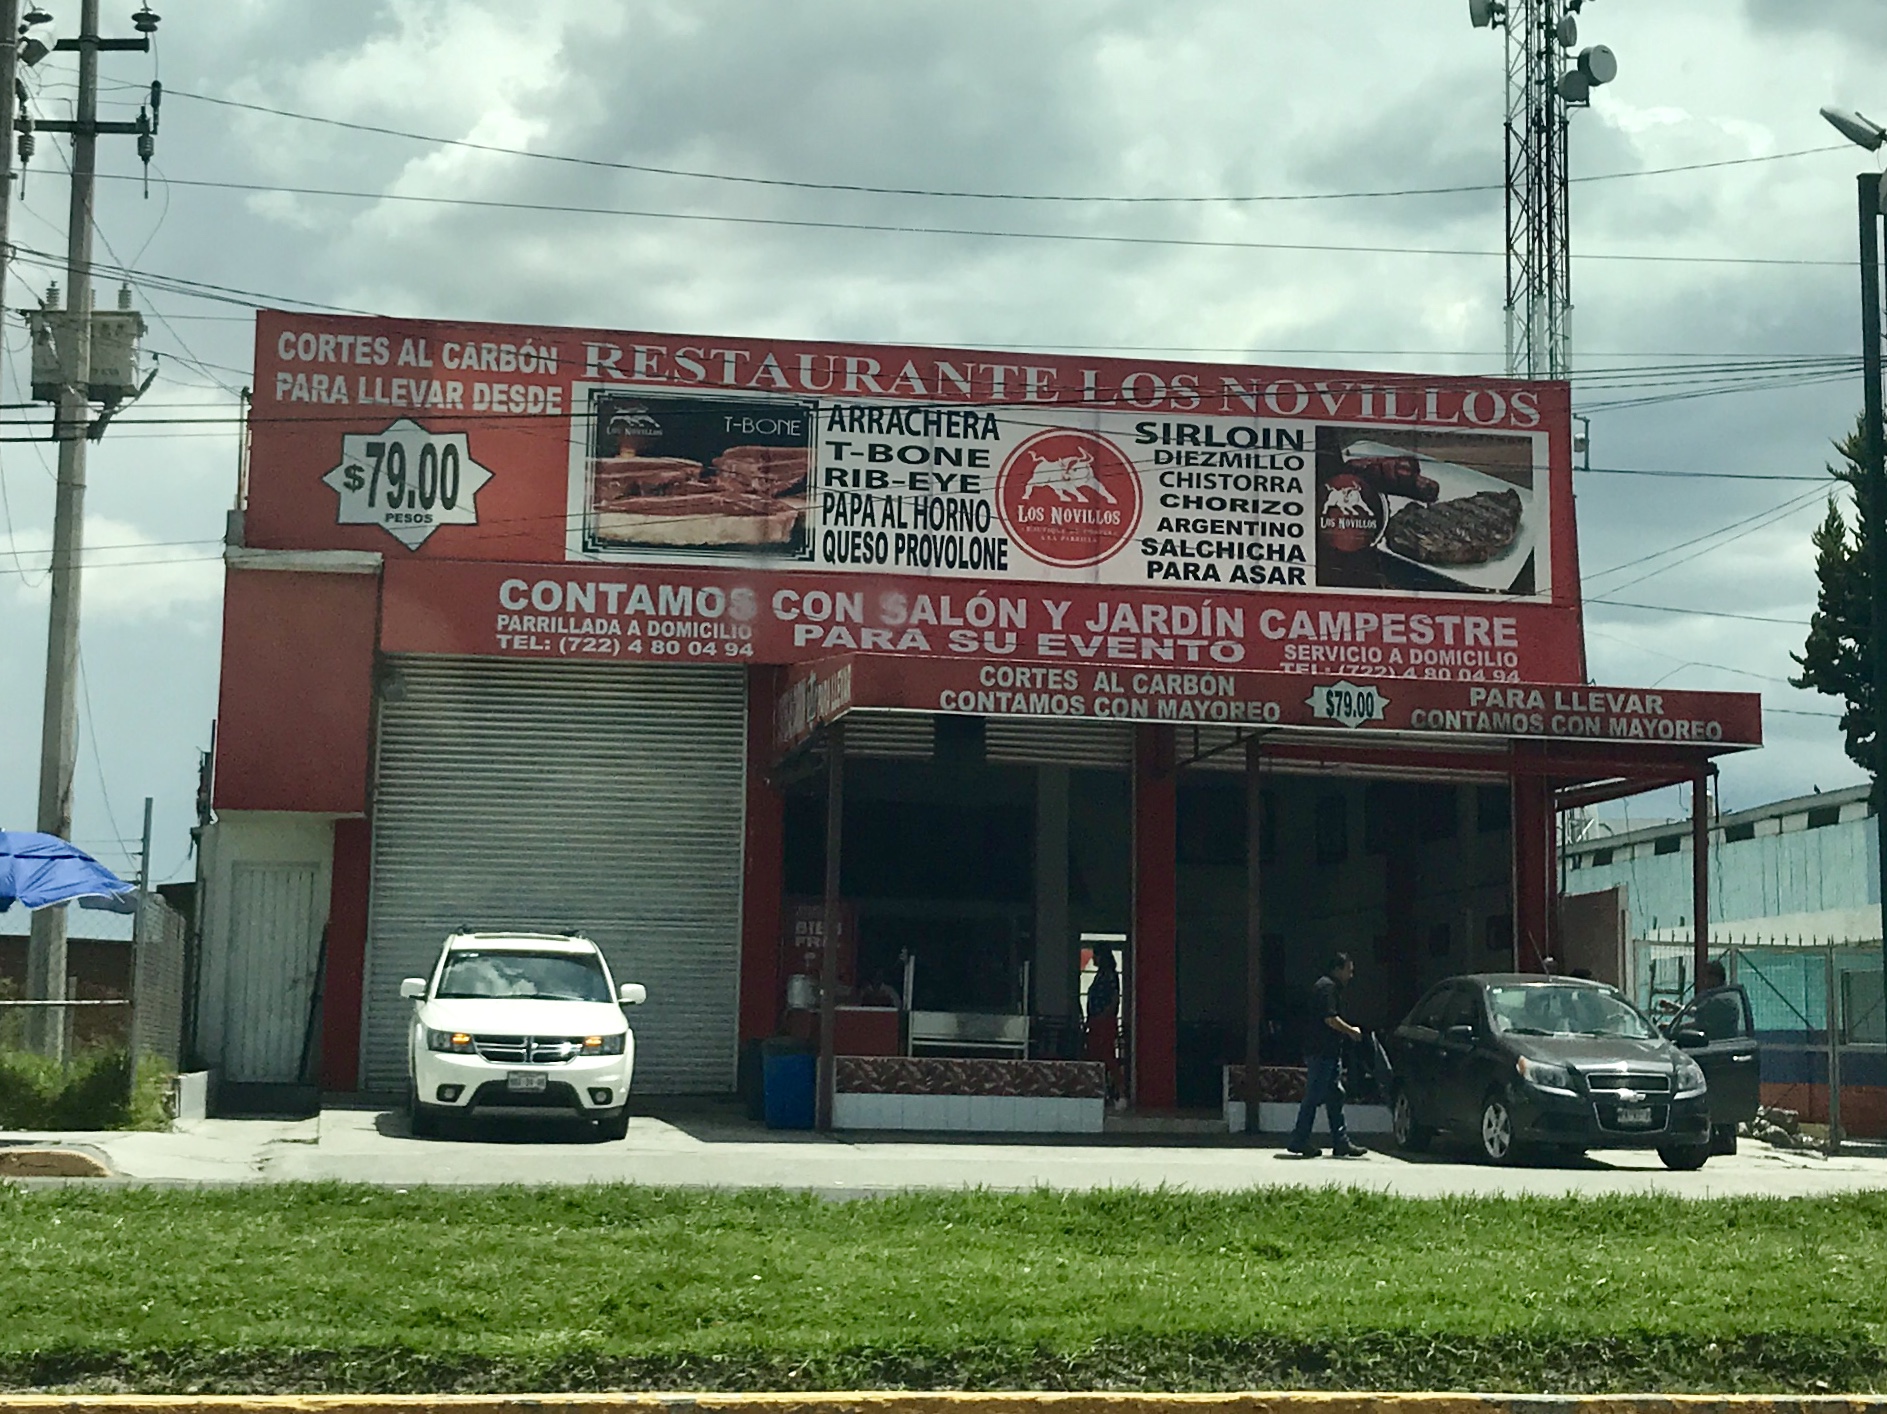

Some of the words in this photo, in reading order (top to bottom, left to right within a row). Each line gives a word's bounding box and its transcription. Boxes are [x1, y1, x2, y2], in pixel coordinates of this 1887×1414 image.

[278, 331, 390, 365] CORTES
[398, 338, 433, 368] AL
[442, 338, 558, 375] CARBÓN
[276, 372, 349, 405] PARA
[358, 376, 464, 410] LLEVAR
[473, 381, 563, 415] DESDE
[580, 341, 1059, 403] RESTAURANTE
[1079, 369, 1201, 411] LOS
[1218, 376, 1541, 428] NOVILLOS
[723, 416, 801, 437] T-BONE
[827, 404, 1000, 441] ARRACHERA
[1135, 421, 1304, 450] SIRLOIN
[825, 440, 991, 469] T-BONE
[1154, 449, 1305, 471] DIEZMILLO
[343, 441, 460, 511] $79.00
[824, 467, 980, 494] RIB-EYE
[1158, 471, 1304, 494] CHISTORRA
[384, 512, 434, 524] PESOS
[822, 492, 875, 528] PAPA
[881, 494, 908, 530] AL
[914, 497, 991, 533] HORNO
[1159, 493, 1304, 516] CHORIZO
[1156, 517, 1304, 538] ARGENTINO
[822, 530, 889, 565] QUESO
[894, 533, 1008, 571] PROVOLONE
[1141, 537, 1307, 563] SALCHICHA
[1147, 561, 1221, 582] PARA
[1229, 564, 1307, 586] ASAR
[497, 614, 621, 636] PARRILLADA
[627, 620, 641, 636] A
[647, 620, 752, 640] DOMICILIO
[500, 579, 758, 621] CONTAMOS
[772, 590, 864, 624] CON
[879, 590, 1027, 629] SALÓN
[1042, 599, 1072, 630] Y
[1086, 599, 1244, 638] JARDÍN
[1260, 609, 1518, 648] CAMPESTRE
[496, 634, 551, 650] TEL:
[559, 637, 620, 656] (722)
[628, 639, 642, 654] 4
[650, 640, 680, 655] 80
[688, 641, 717, 656] 04
[724, 642, 753, 657] 94
[794, 624, 931, 651] PARA
[948, 629, 1017, 654] SU
[1037, 633, 1246, 663] EVENTO
[1284, 644, 1382, 663] SERVICIO
[1389, 648, 1403, 664] A
[1410, 648, 1518, 668] DOMICILIO
[979, 665, 1078, 691] CORTES
[1093, 671, 1124, 694] AL
[940, 690, 1085, 715] CONTAMOS
[1094, 697, 1148, 718] CON
[1158, 698, 1280, 723] MAYOREO
[1326, 690, 1374, 718] $79.00
[1470, 687, 1545, 710] PARA
[1555, 691, 1664, 715] LLEVAR
[1411, 708, 1544, 735] CONTAMOS
[1551, 714, 1600, 736] CON
[1609, 717, 1722, 742] MAYOREO
